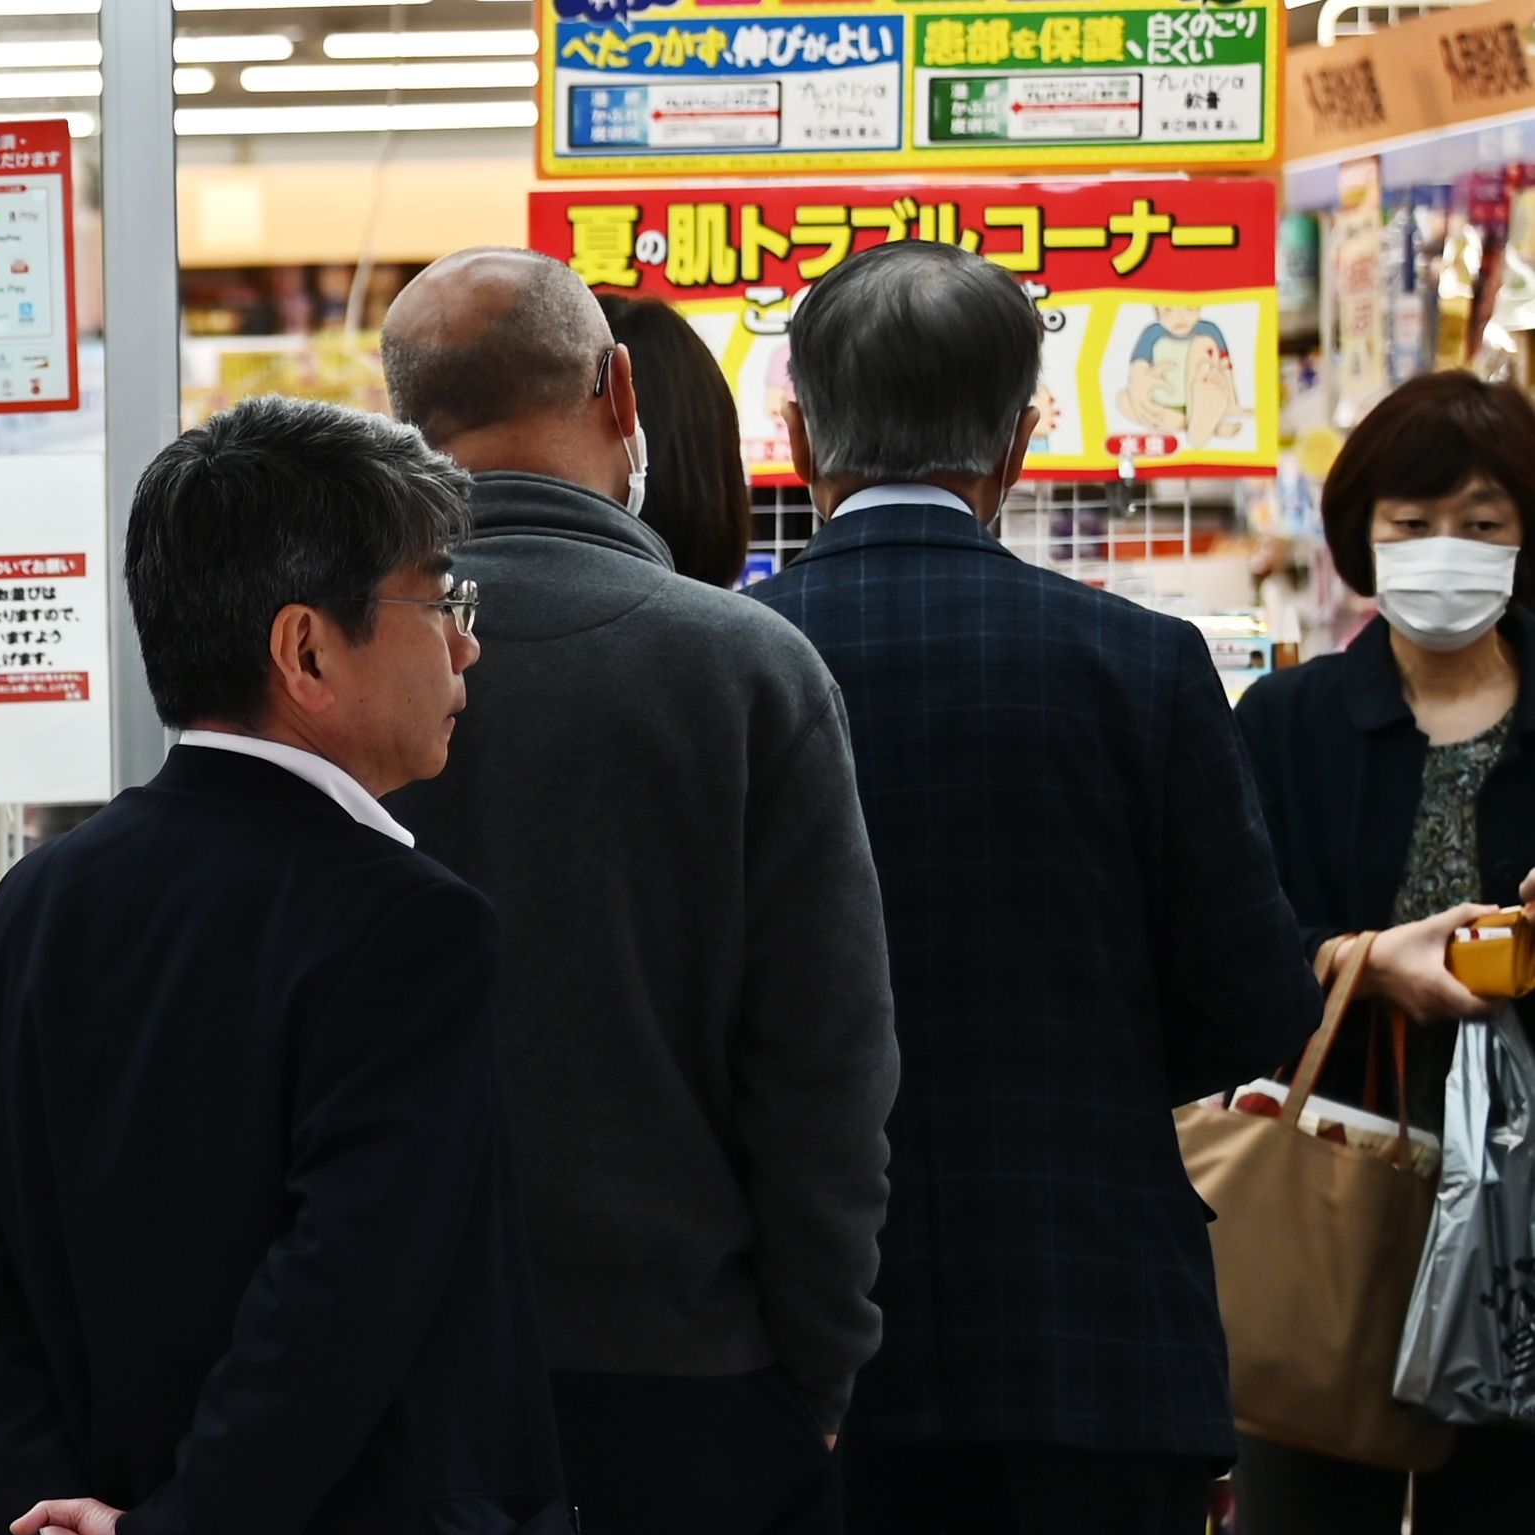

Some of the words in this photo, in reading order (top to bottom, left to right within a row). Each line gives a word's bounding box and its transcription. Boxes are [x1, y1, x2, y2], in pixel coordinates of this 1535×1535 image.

[1147, 12, 1257, 38] 白くのこり
[1147, 41, 1213, 64] にくい
[568, 197, 1236, 287] 夏の肌トラブルコーナー
